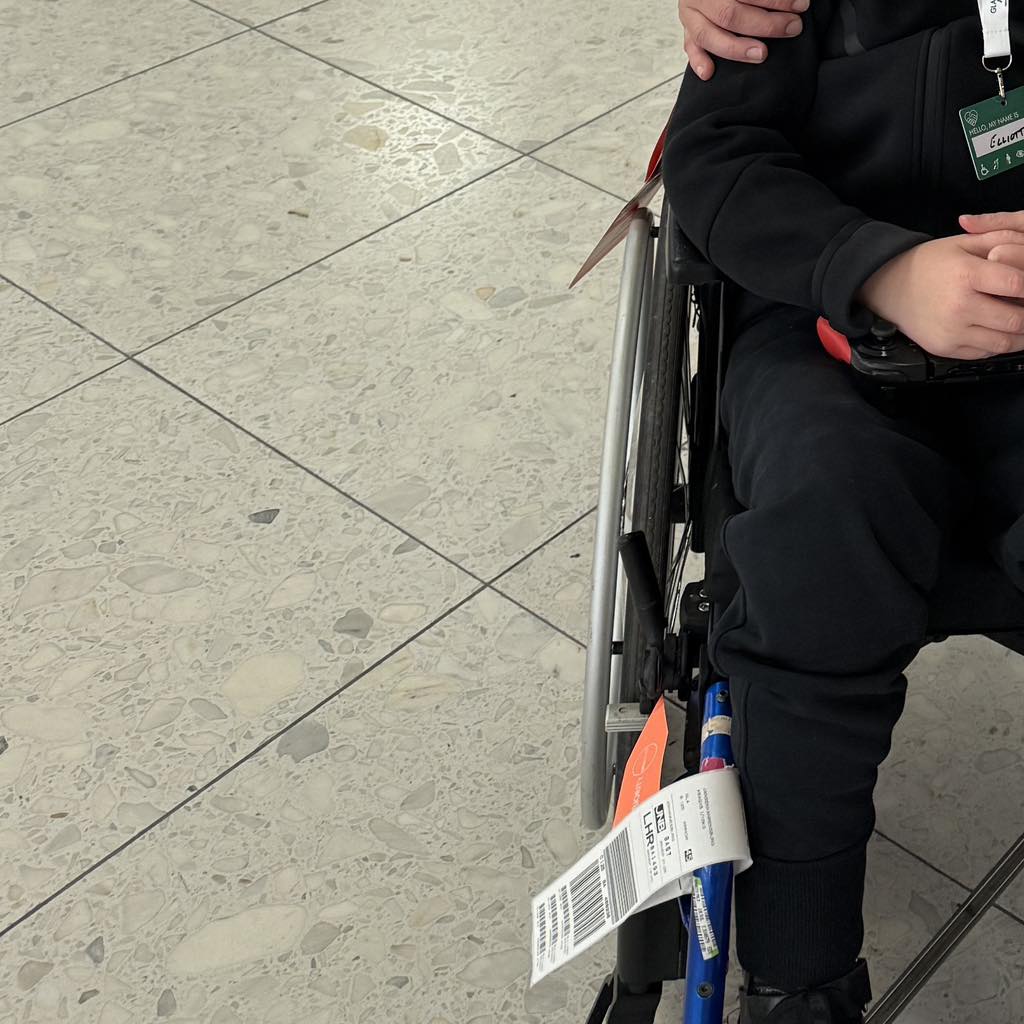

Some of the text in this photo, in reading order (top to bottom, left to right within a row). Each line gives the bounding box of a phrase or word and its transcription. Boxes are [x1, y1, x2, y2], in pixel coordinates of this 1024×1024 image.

[988, 120, 997, 129] MY
[997, 114, 1014, 125] NAME
[643, 811, 655, 847] LHR
[656, 804, 666, 832] JNB
